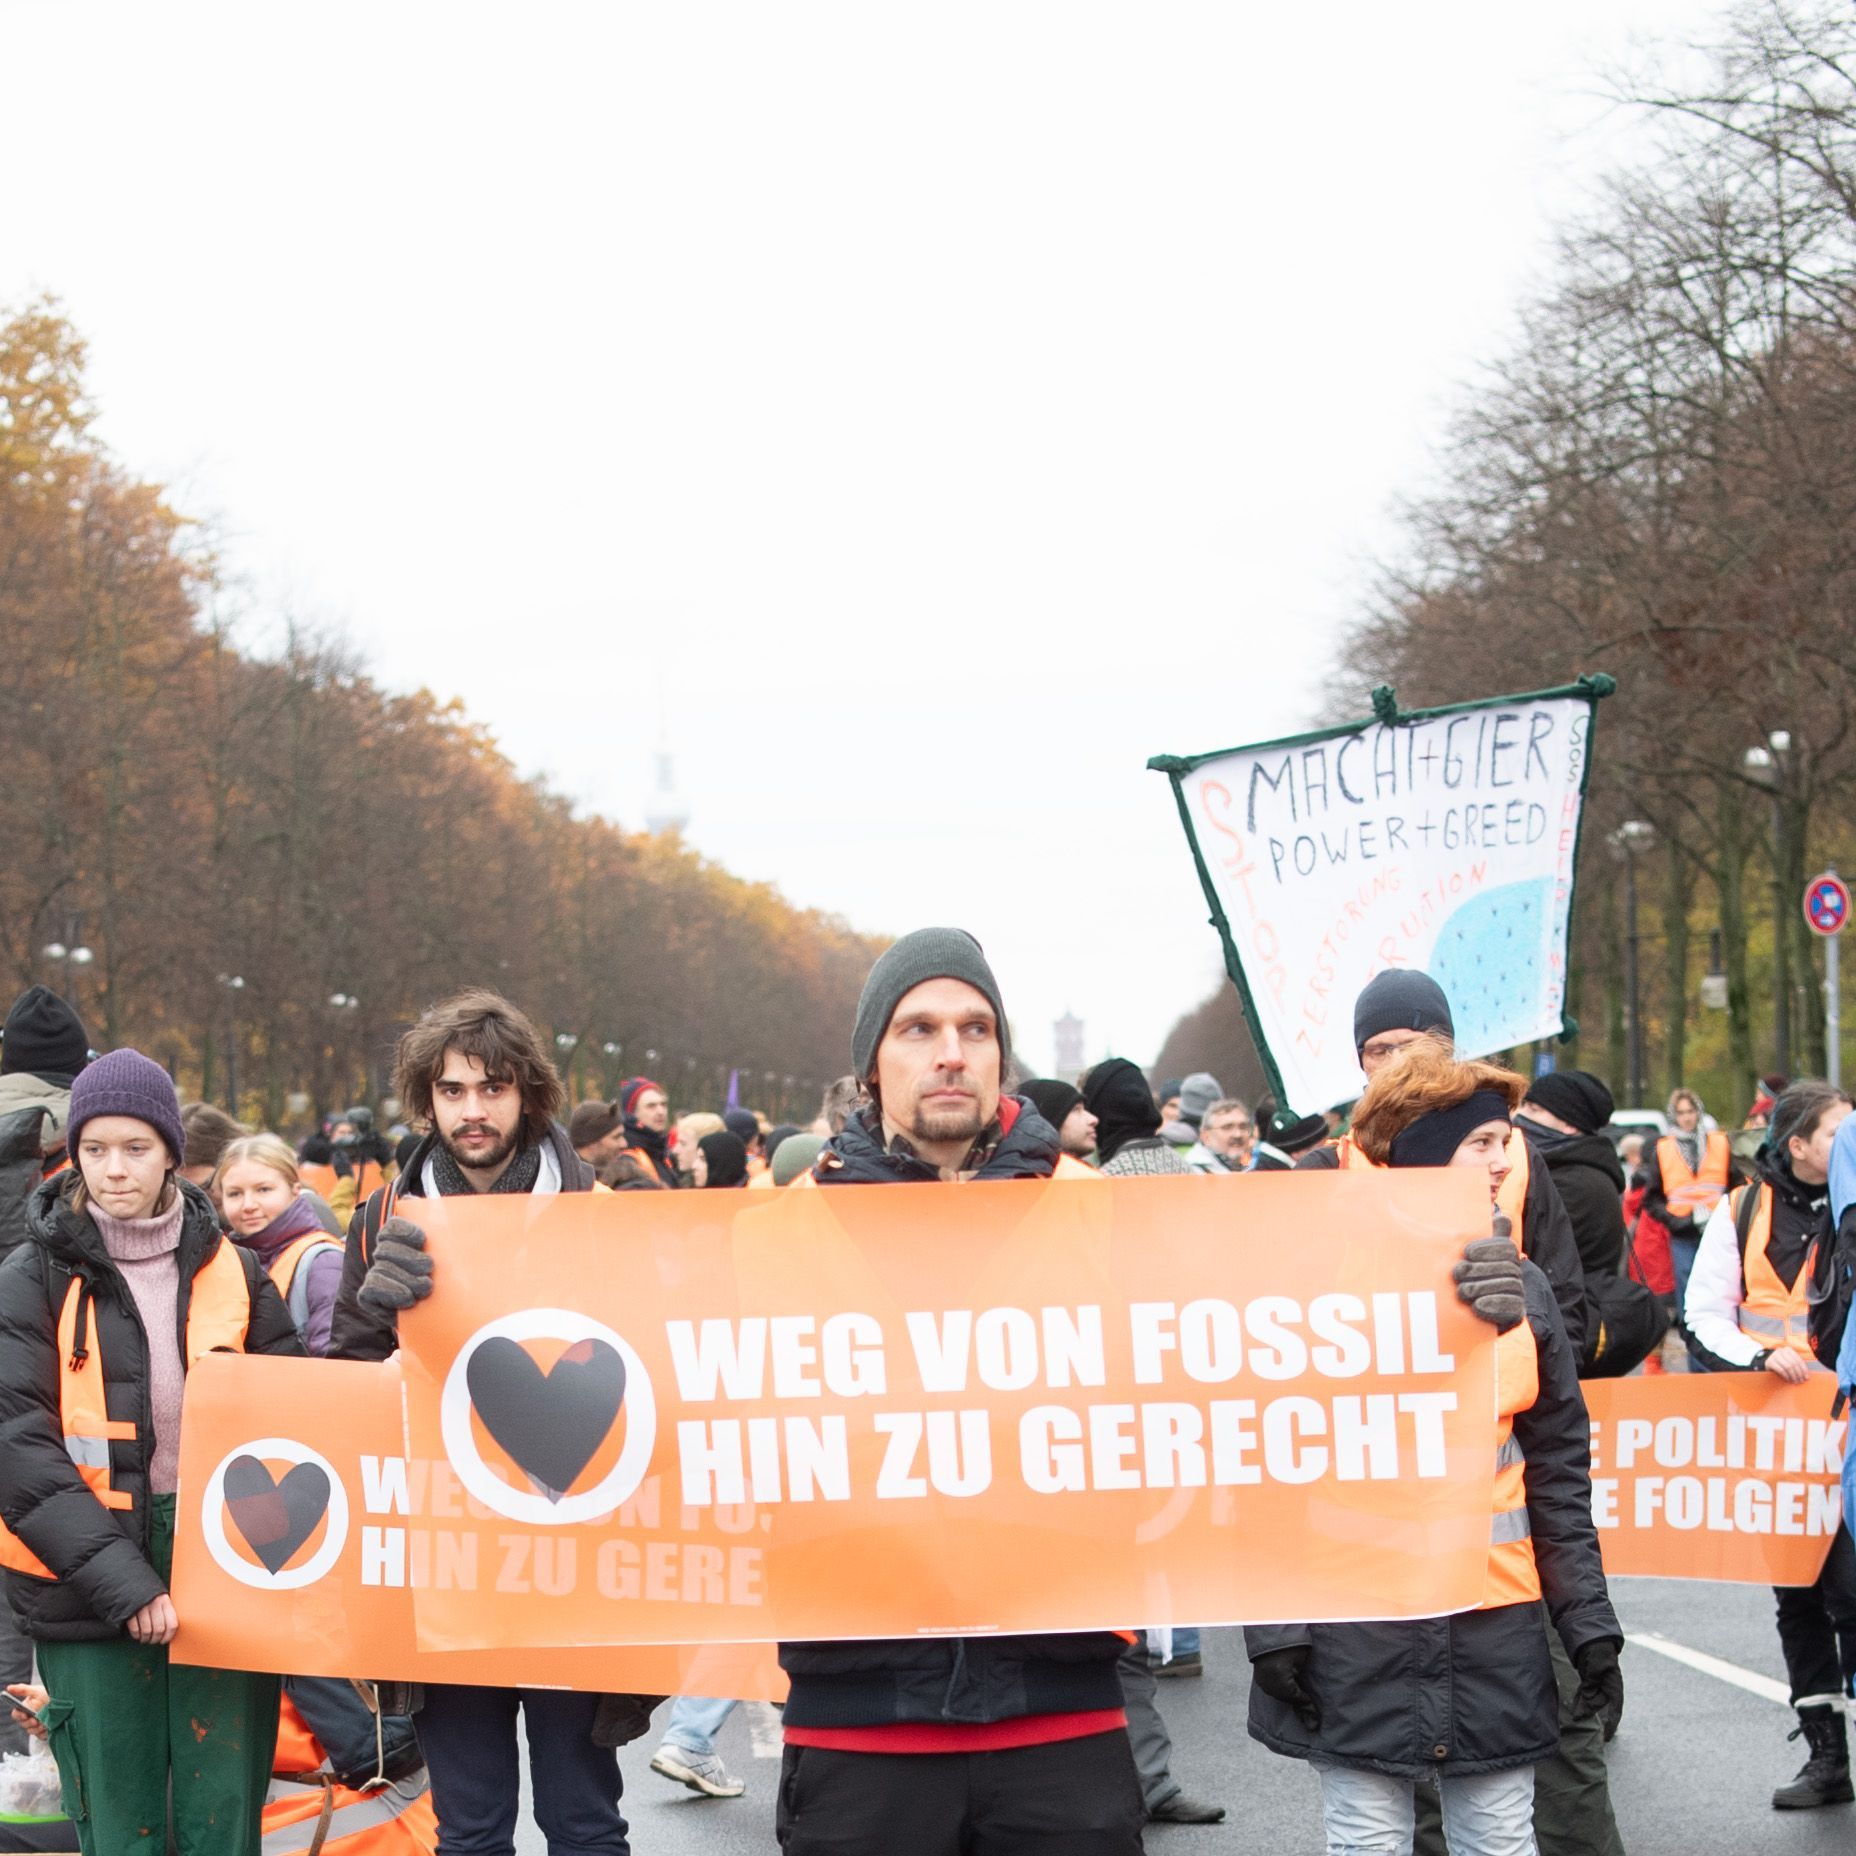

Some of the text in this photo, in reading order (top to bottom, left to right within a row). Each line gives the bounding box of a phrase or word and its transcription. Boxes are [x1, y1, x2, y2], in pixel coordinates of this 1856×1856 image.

[1200, 779, 1285, 1015] STOP
[666, 1291, 1455, 1401] WEG VON FOSSIL
[678, 1417, 848, 1505] HIN
[874, 1410, 993, 1498] ZU
[1019, 1394, 1457, 1494] GERECHT
[1616, 1416, 1848, 1474] POLITIK
[1635, 1475, 1842, 1537] FOLGEN
[596, 1538, 766, 1607] GERE
